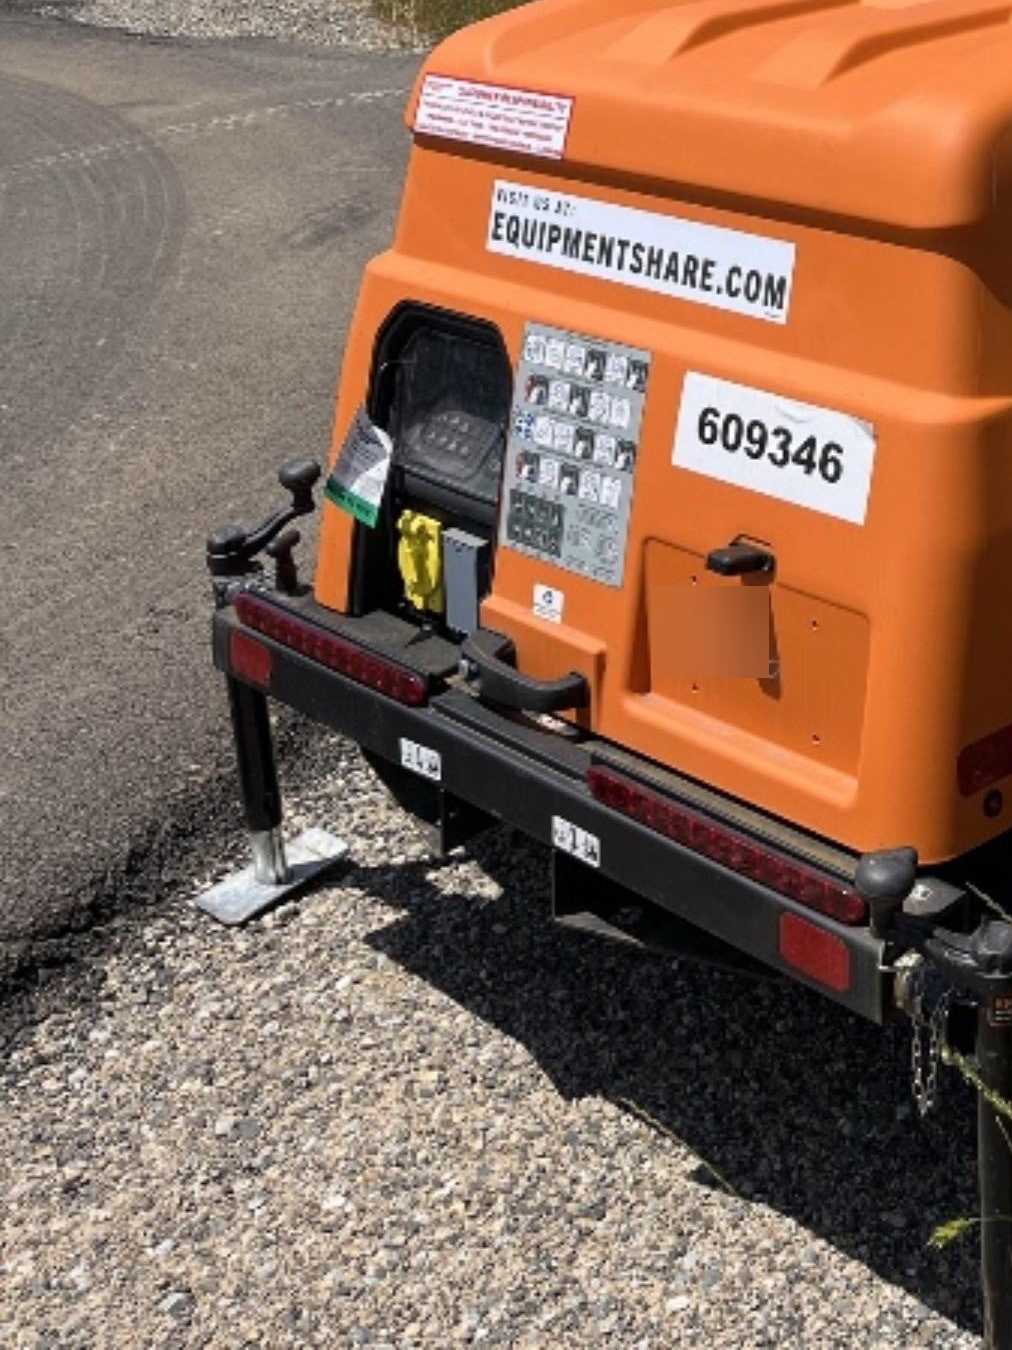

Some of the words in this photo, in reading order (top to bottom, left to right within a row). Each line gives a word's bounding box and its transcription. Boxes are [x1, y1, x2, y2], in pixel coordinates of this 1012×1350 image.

[496, 188, 529, 207] VISIT
[533, 195, 550, 212] US
[491, 211, 787, 310] EQUIPMENTSHARE.COM
[698, 406, 844, 484] 609346
